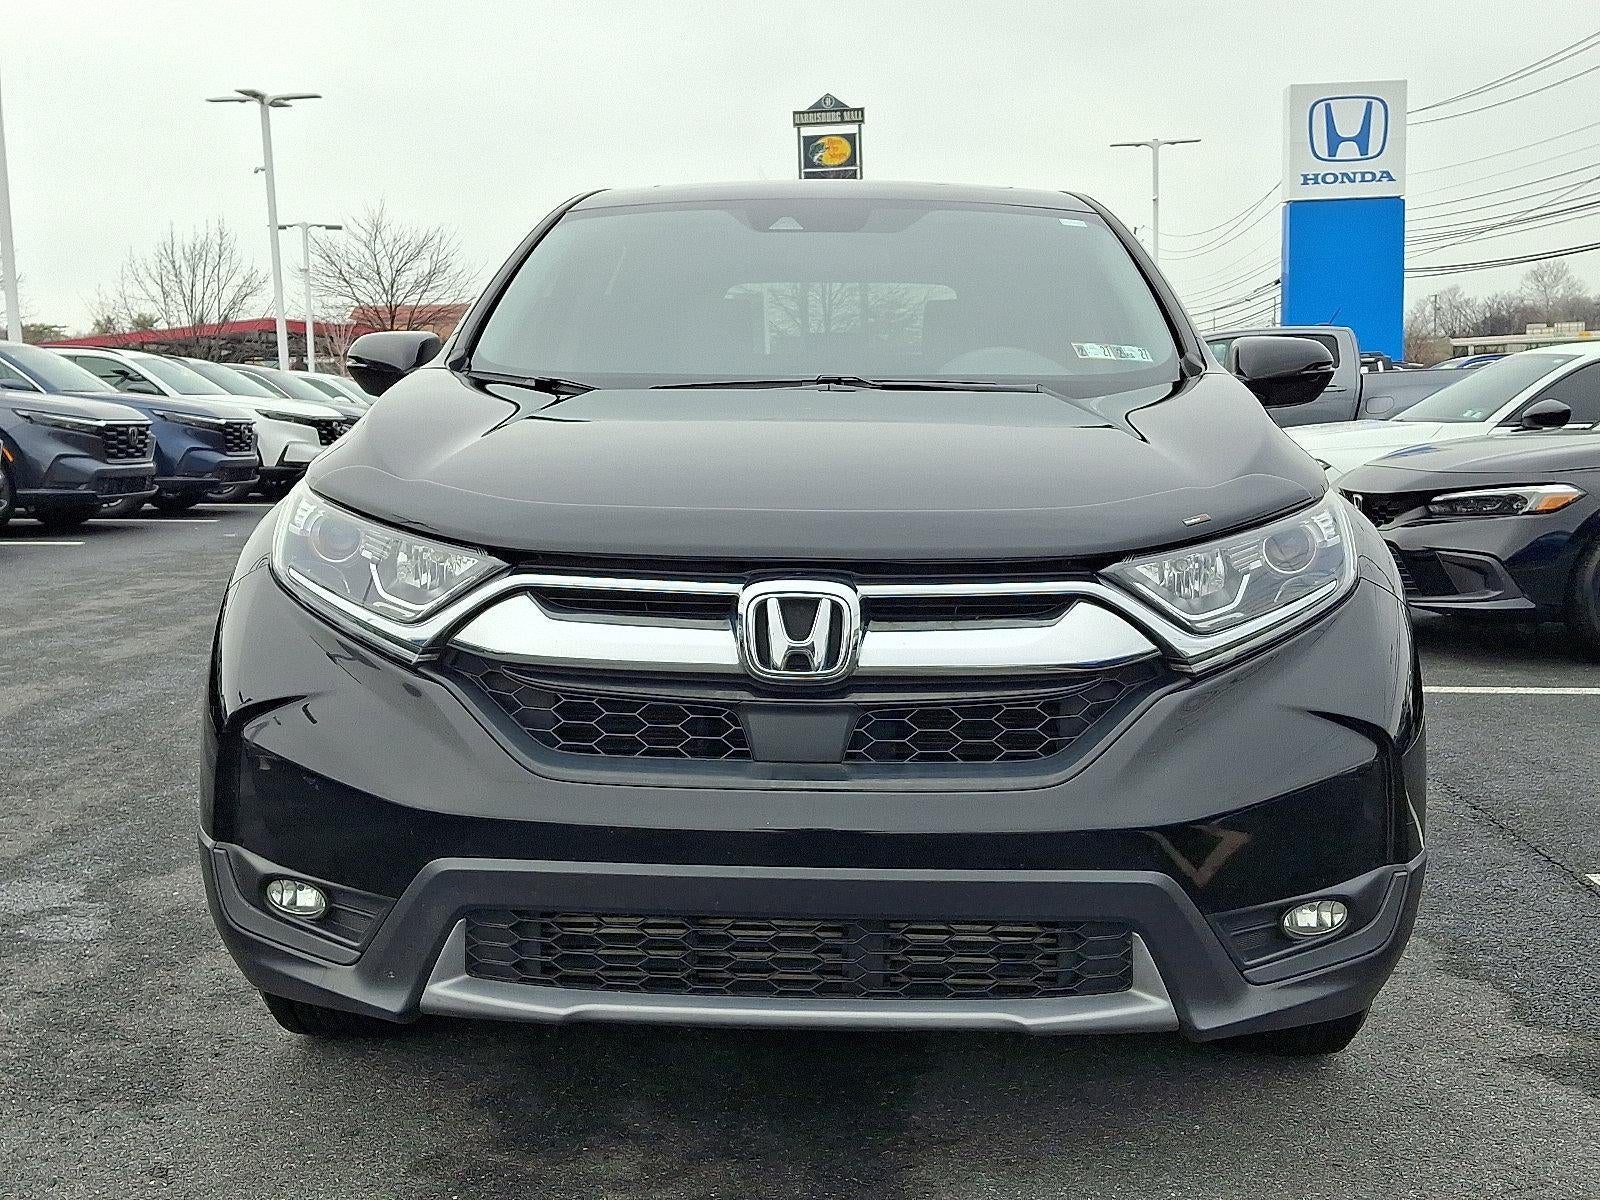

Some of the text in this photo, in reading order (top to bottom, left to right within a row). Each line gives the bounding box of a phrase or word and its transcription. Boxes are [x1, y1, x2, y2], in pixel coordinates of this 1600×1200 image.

[794, 110, 863, 124] HARRISBURG MALL
[1300, 170, 1397, 186] HONDA
